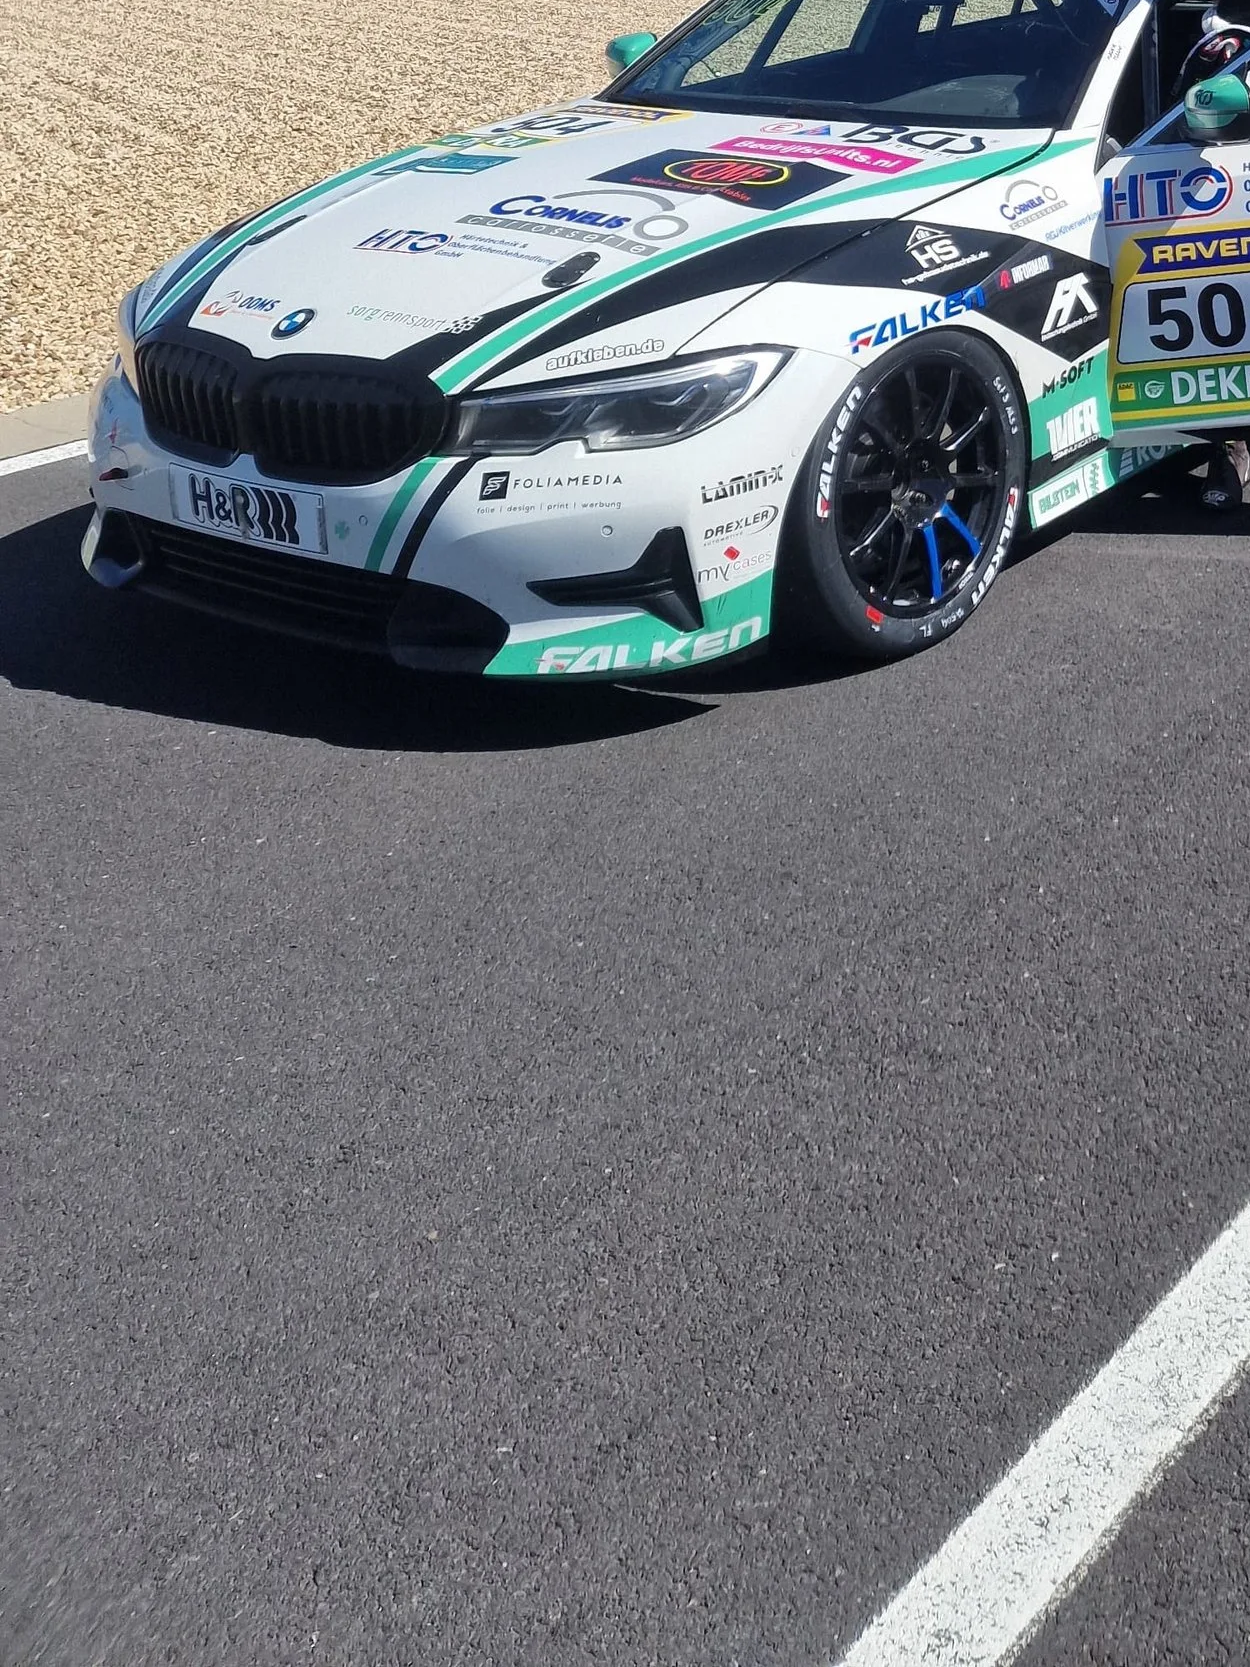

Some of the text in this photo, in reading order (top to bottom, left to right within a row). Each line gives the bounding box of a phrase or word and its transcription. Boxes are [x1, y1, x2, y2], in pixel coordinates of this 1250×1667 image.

[842, 121, 987, 154] BGS
[466, 215, 647, 254] carrosserie
[910, 238, 960, 269] HS
[347, 303, 447, 331] sorg rennsport
[849, 284, 987, 354] FALKEN
[545, 339, 665, 371] aufkleben.de
[816, 385, 863, 519] FALKEN
[513, 474, 624, 489] FOLIAMEDIA
[188, 473, 258, 532] H&R
[476, 500, 622, 515] folie design print werbung
[704, 509, 770, 540] DREXLER
[971, 487, 1018, 607] FALKEN
[535, 616, 762, 675] FALKEN
